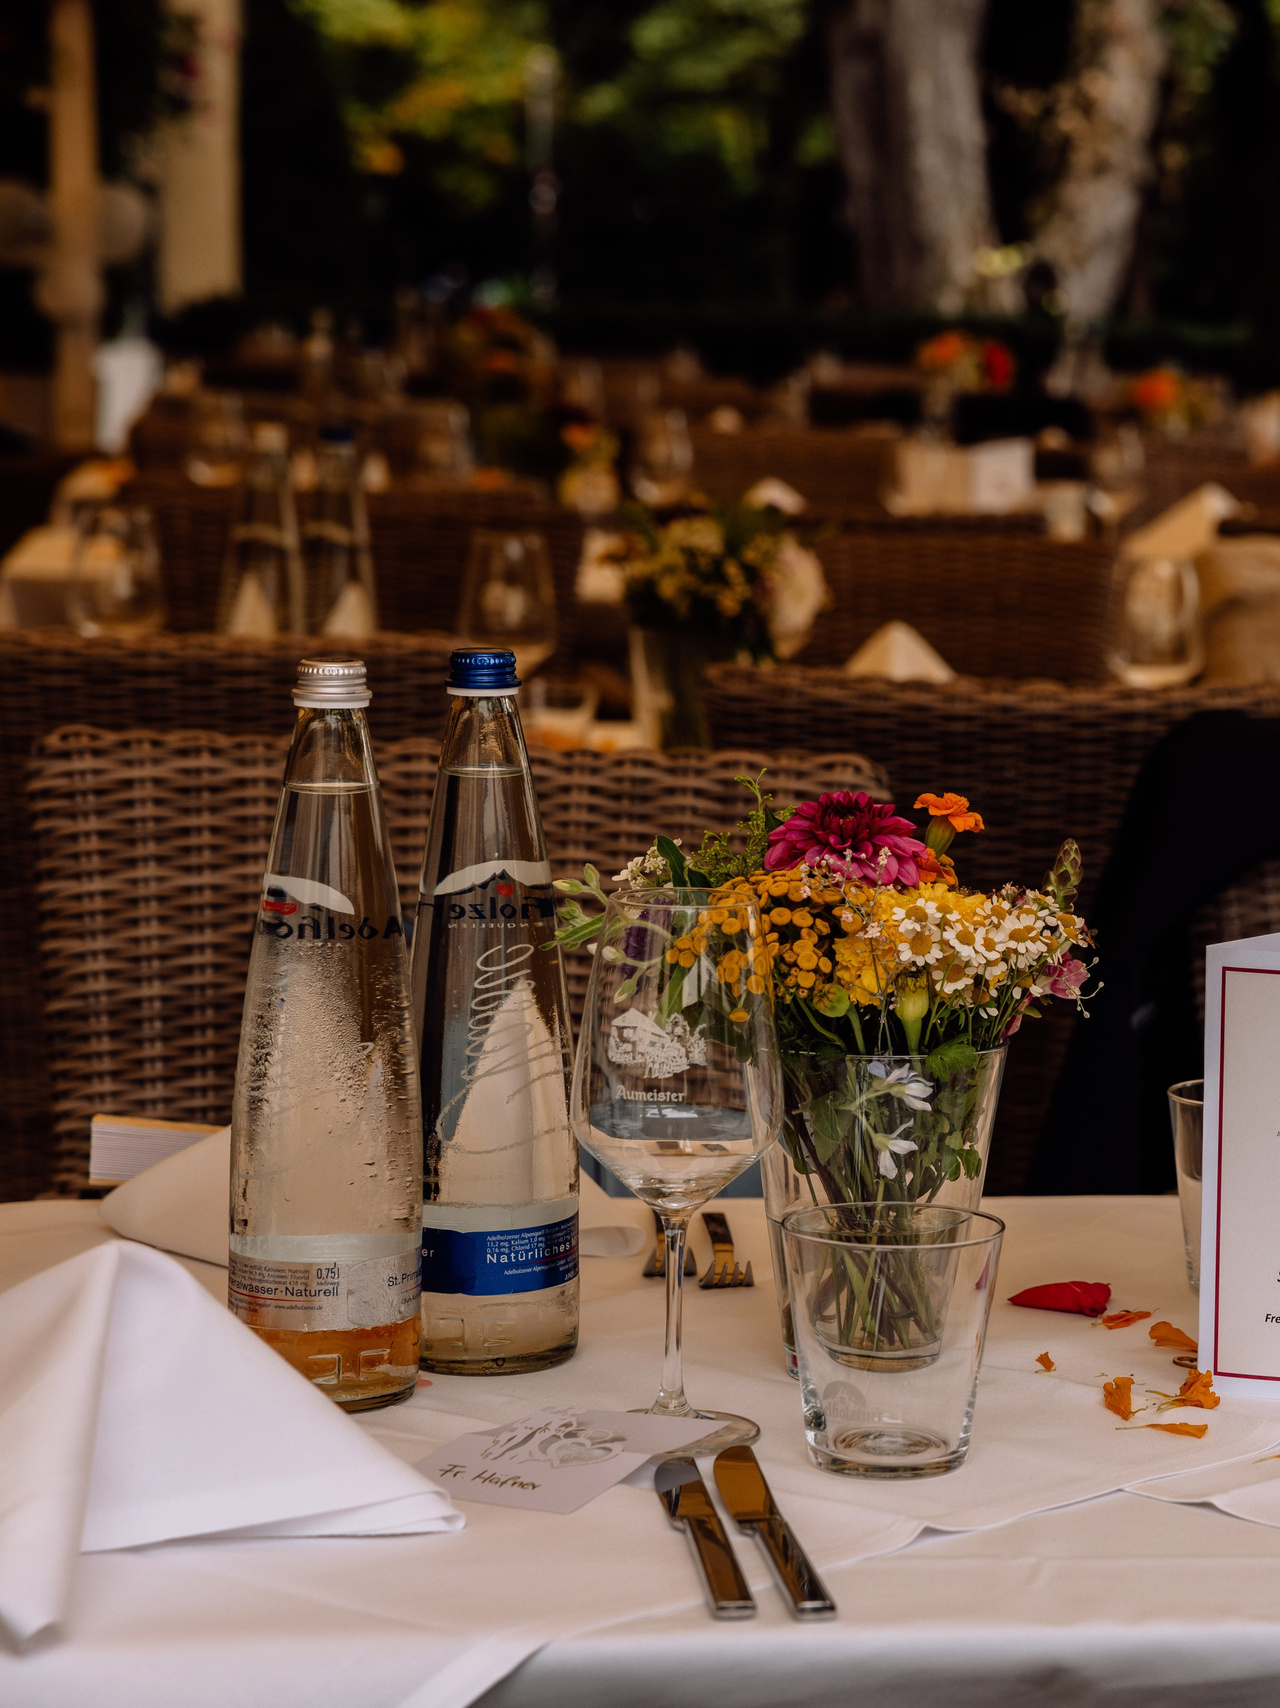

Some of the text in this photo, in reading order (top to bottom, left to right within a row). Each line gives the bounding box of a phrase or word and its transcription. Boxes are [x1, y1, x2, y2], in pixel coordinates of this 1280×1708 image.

[616, 1085, 685, 1102] Aumeister
[486, 1233, 520, 1241] Adelholzener
[486, 1241, 570, 1264] Natürliches
[511, 1244, 530, 1252] Chlorid
[387, 1276, 401, 1287] St.
[285, 1286, 339, 1297] Naturell
